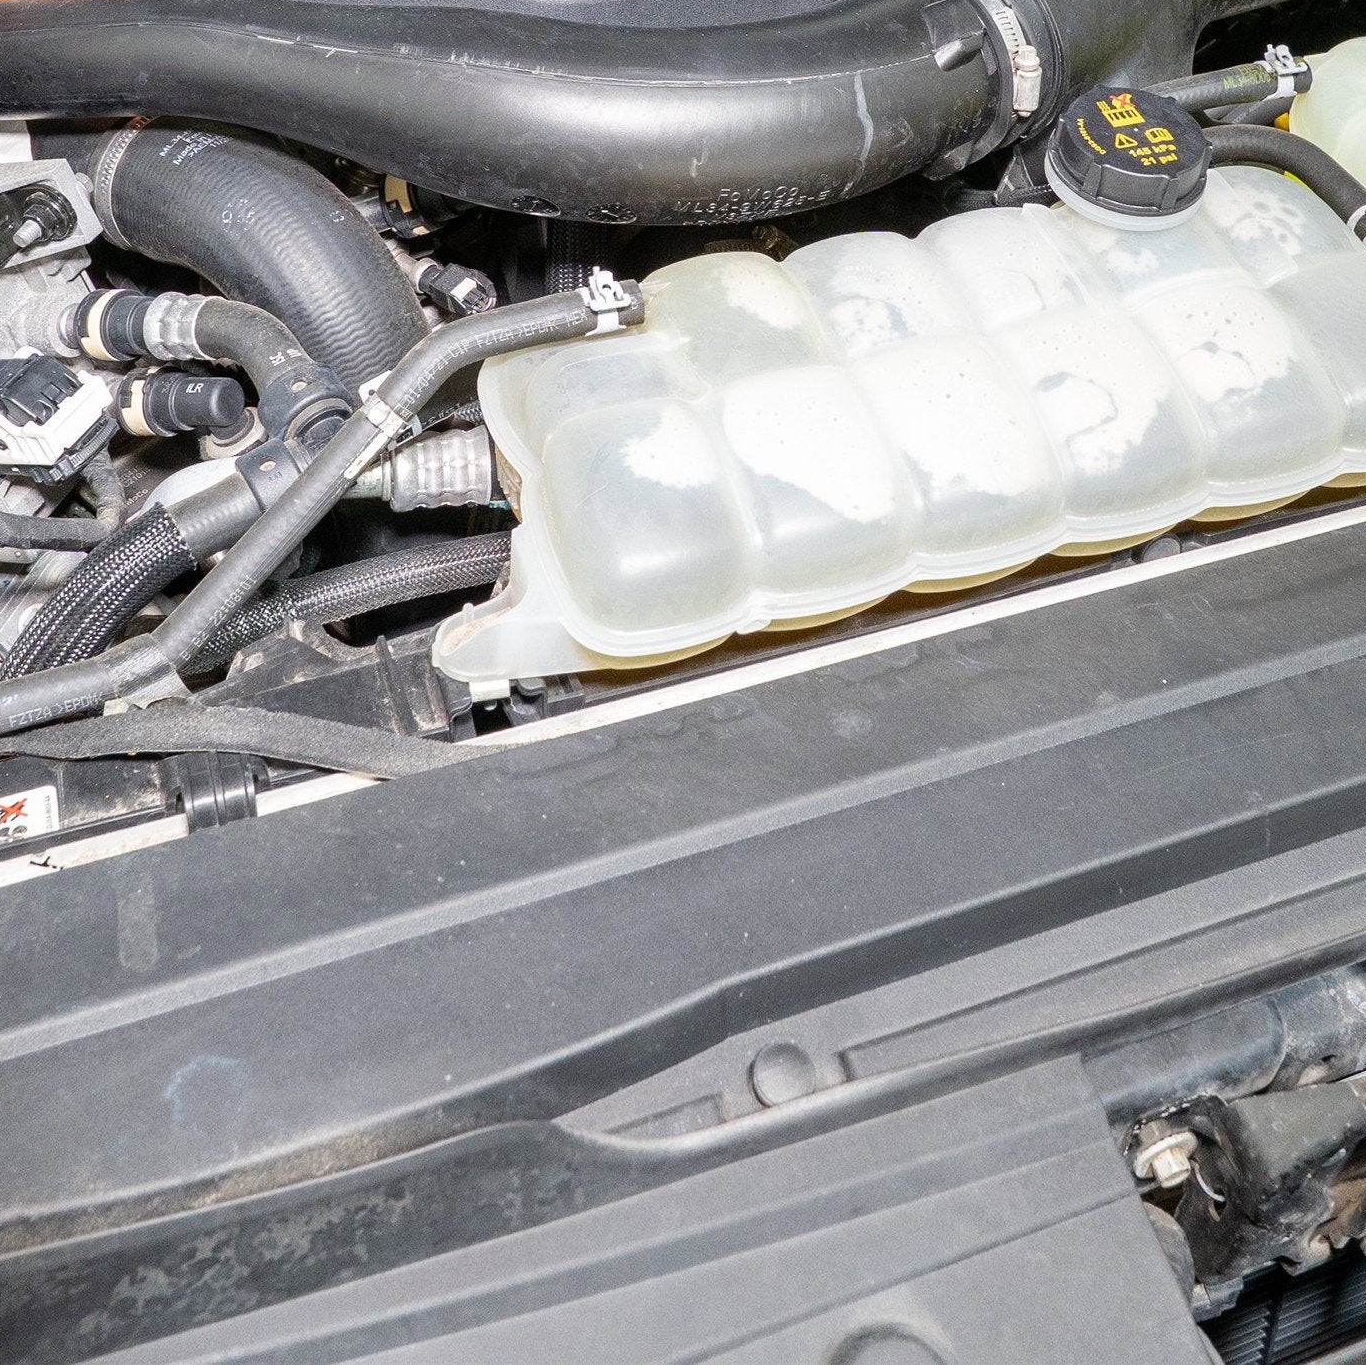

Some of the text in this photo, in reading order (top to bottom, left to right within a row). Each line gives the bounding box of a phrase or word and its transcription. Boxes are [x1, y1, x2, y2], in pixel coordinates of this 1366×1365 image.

[173, 142, 197, 165] Made
[1129, 144, 1177, 158] 145 kPa
[1141, 153, 1178, 166] 21 psi
[717, 186, 799, 202] FoMoCo
[566, 309, 588, 327] MEX
[9, 706, 53, 726] FZTZA
